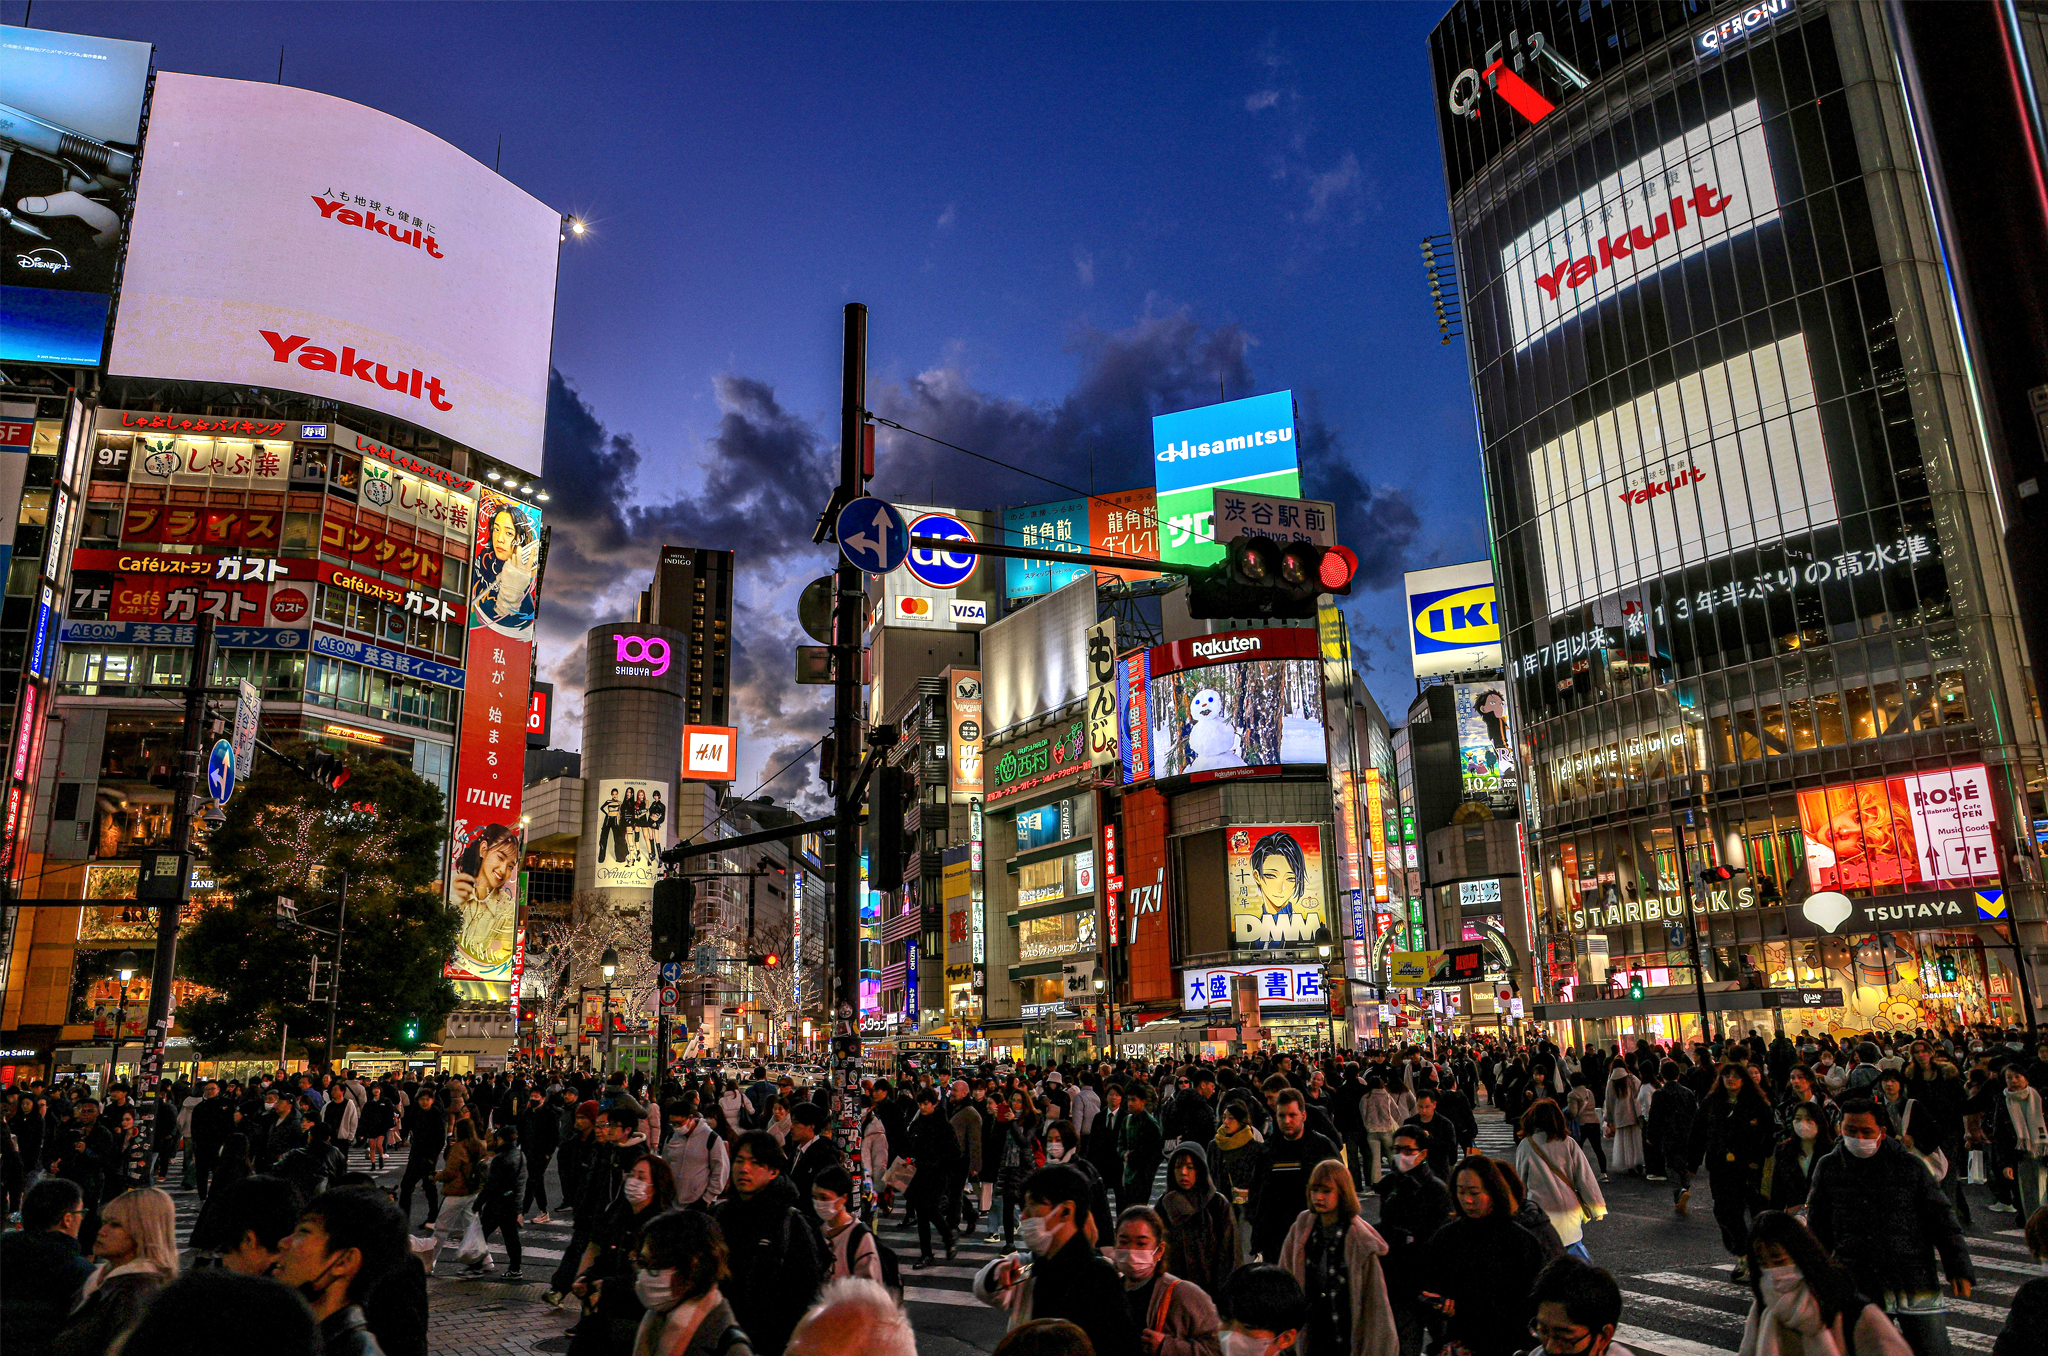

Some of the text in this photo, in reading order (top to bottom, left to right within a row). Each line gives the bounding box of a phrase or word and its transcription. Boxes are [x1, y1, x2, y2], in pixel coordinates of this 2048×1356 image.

[323, 187, 436, 235] 人も地球も健康に
[311, 195, 444, 259] Yakult
[1535, 183, 1733, 301] Yakult
[259, 329, 451, 412] Yakult
[122, 412, 286, 436] しゃぶしゃぶバイキング
[302, 425, 326, 438] 寿司
[98, 449, 128, 465] 9F
[1156, 427, 1293, 463] Hisamitsu
[188, 448, 280, 478] しゃぶ葉
[356, 435, 475, 493] しゃぶしゃぶバイキング
[1618, 465, 1707, 507] Yakult
[400, 483, 469, 529] しゃぶ葉
[1224, 498, 1326, 532] 渋谷駅前
[128, 509, 277, 542] プライス
[1022, 518, 1072, 548] 龍角散
[322, 520, 440, 578] コンタクト
[664, 557, 691, 566] INDIGO
[214, 555, 289, 582] ガスト
[73, 587, 111, 610] 7F
[119, 587, 257, 622] Café ガスト
[274, 602, 304, 613] ガスト
[404, 590, 456, 622] ガスト
[952, 603, 985, 619] VISA
[69, 623, 116, 639] AEON
[901, 613, 928, 621] mastercard
[133, 624, 195, 644] 英会話
[276, 631, 300, 647] 6F
[1192, 635, 1261, 659] Rakuten
[320, 635, 463, 684] AEON 英会話 イーオン
[613, 634, 671, 677] 109
[615, 666, 650, 677] SHIBUYA
[1088, 626, 1118, 758] もんじゃ
[486, 646, 508, 781] 私が、始まる。
[1128, 659, 1144, 774] 三千里薬品
[695, 742, 723, 761] H&M
[1017, 748, 1049, 778] 西村
[1214, 768, 1255, 778] Rakuten Vision
[1367, 771, 1382, 845] クスリのことなら
[1913, 779, 1980, 807] ROSÉ
[1963, 802, 1981, 811] Cafe
[1937, 823, 1989, 836] Music Goods
[1952, 809, 1983, 820] OPEN
[1954, 845, 1988, 867] 7F
[597, 867, 635, 880] Winter
[1372, 851, 1388, 897] 三千里
[1470, 882, 1499, 892] れいわ
[1462, 891, 1500, 904] クリニック
[1574, 887, 1754, 929] STARBUCKS
[1864, 900, 1963, 922] TSUTAYA
[949, 909, 968, 943] 薬
[1190, 971, 1319, 1002] 大盛書店
[11, 1048, 35, 1057] Salita
